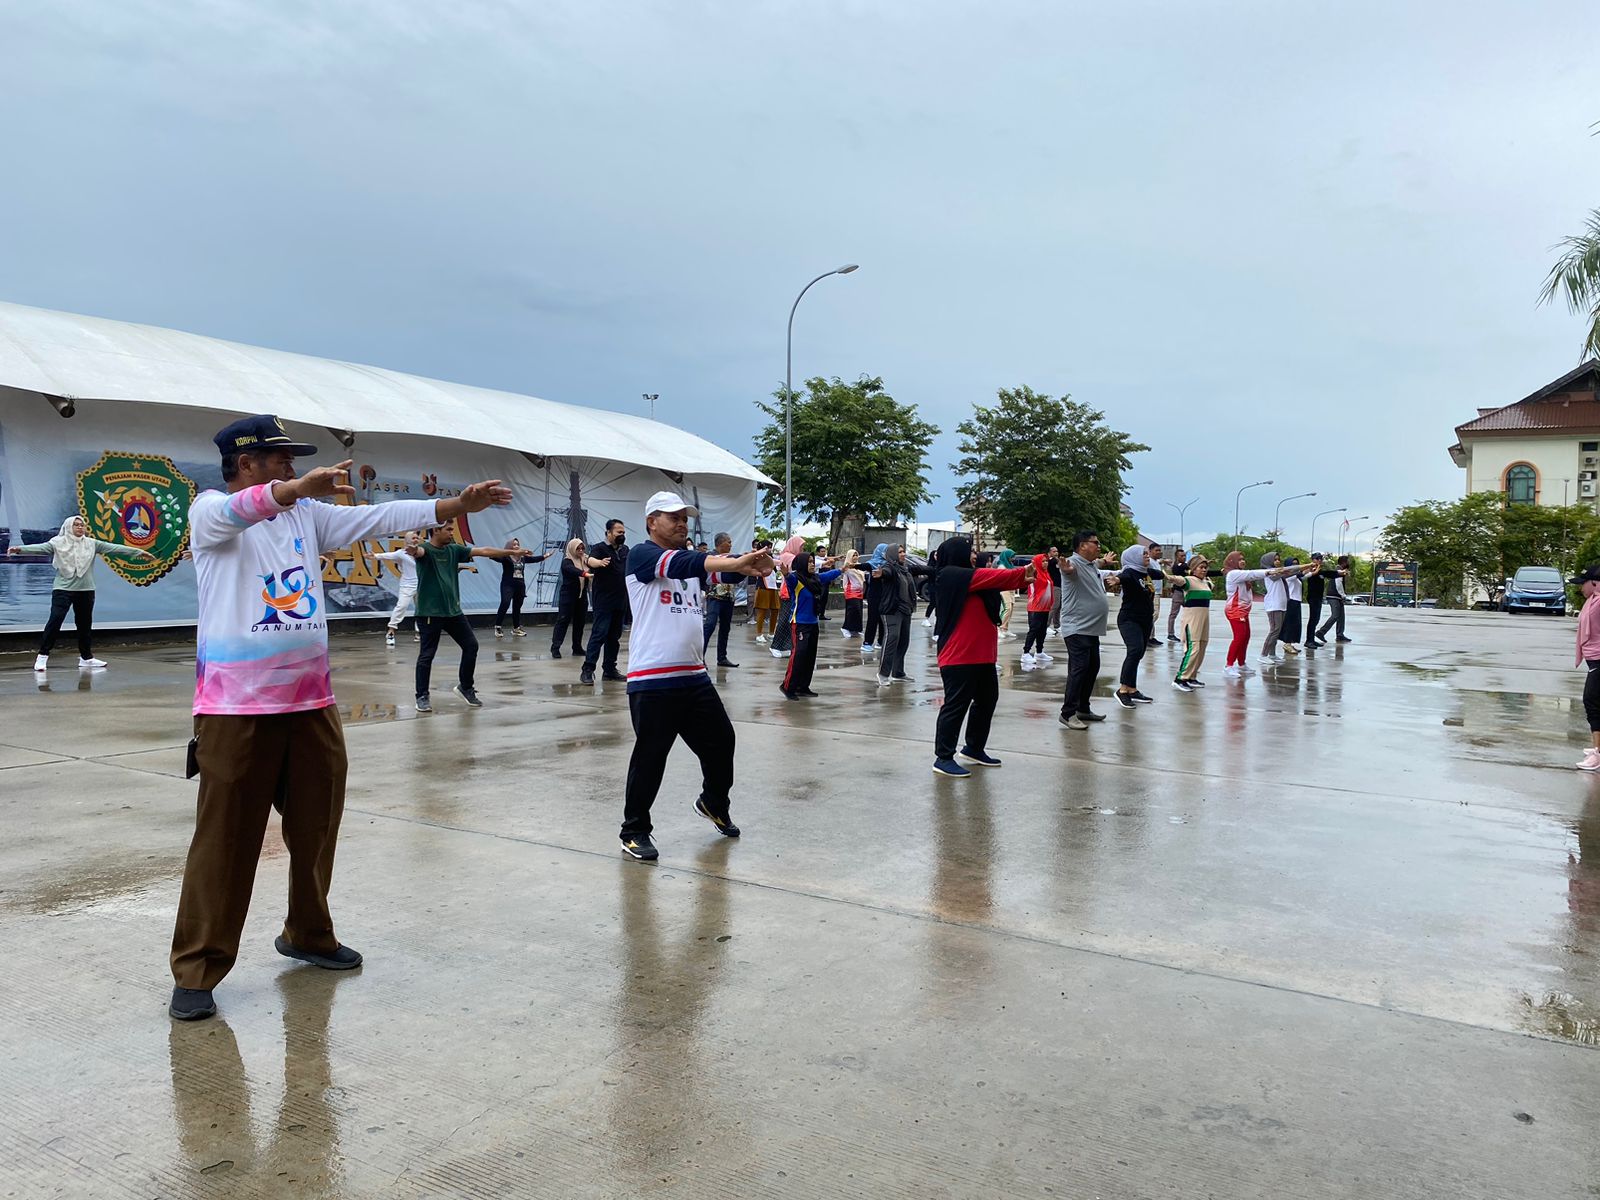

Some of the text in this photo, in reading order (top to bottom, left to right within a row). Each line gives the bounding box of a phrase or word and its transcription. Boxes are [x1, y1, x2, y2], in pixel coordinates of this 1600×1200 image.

[105, 473, 132, 482] PENAJAM
[151, 475, 169, 485] UTARA
[670, 606, 688, 614] EST
[251, 624, 302, 633] DANUM
